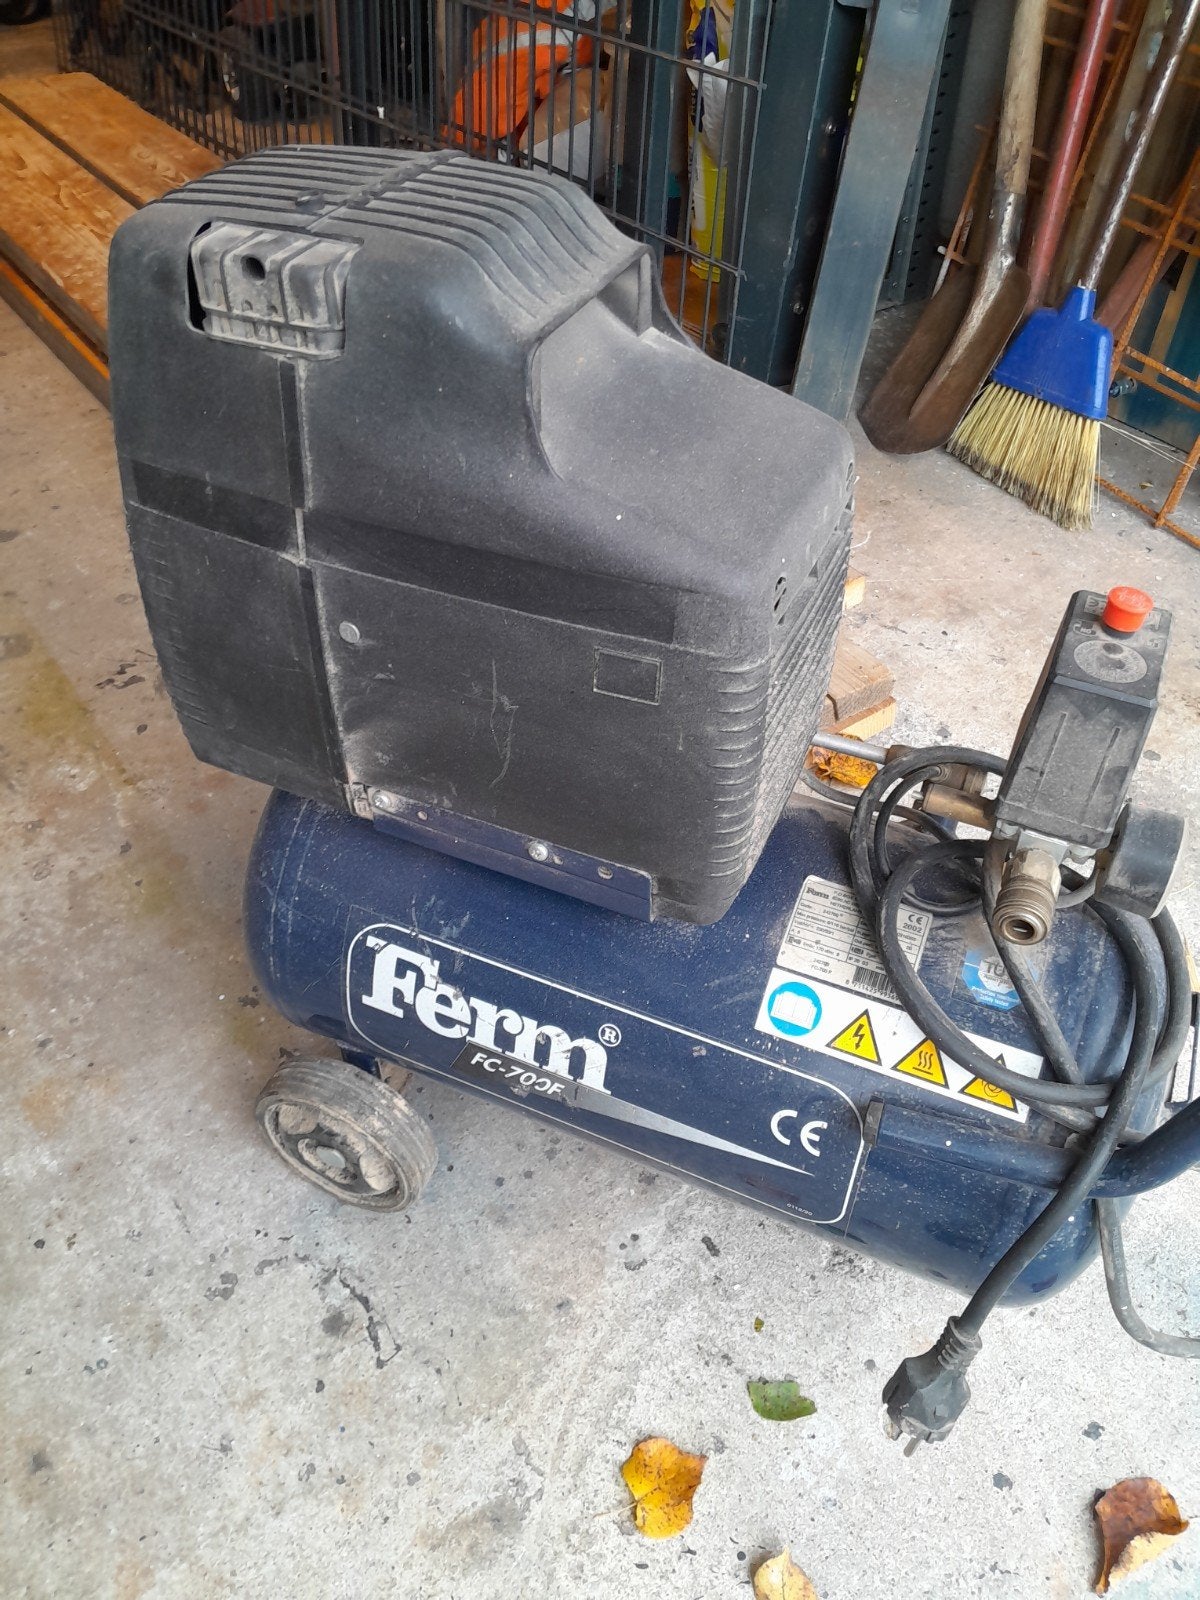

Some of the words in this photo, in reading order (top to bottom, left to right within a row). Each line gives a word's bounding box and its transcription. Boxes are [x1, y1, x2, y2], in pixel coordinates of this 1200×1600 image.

[902, 922, 923, 934] 2002
[362, 936, 612, 1095] Ferm
[470, 1052, 565, 1095] FC-700F
[770, 1109, 828, 1157] CE
